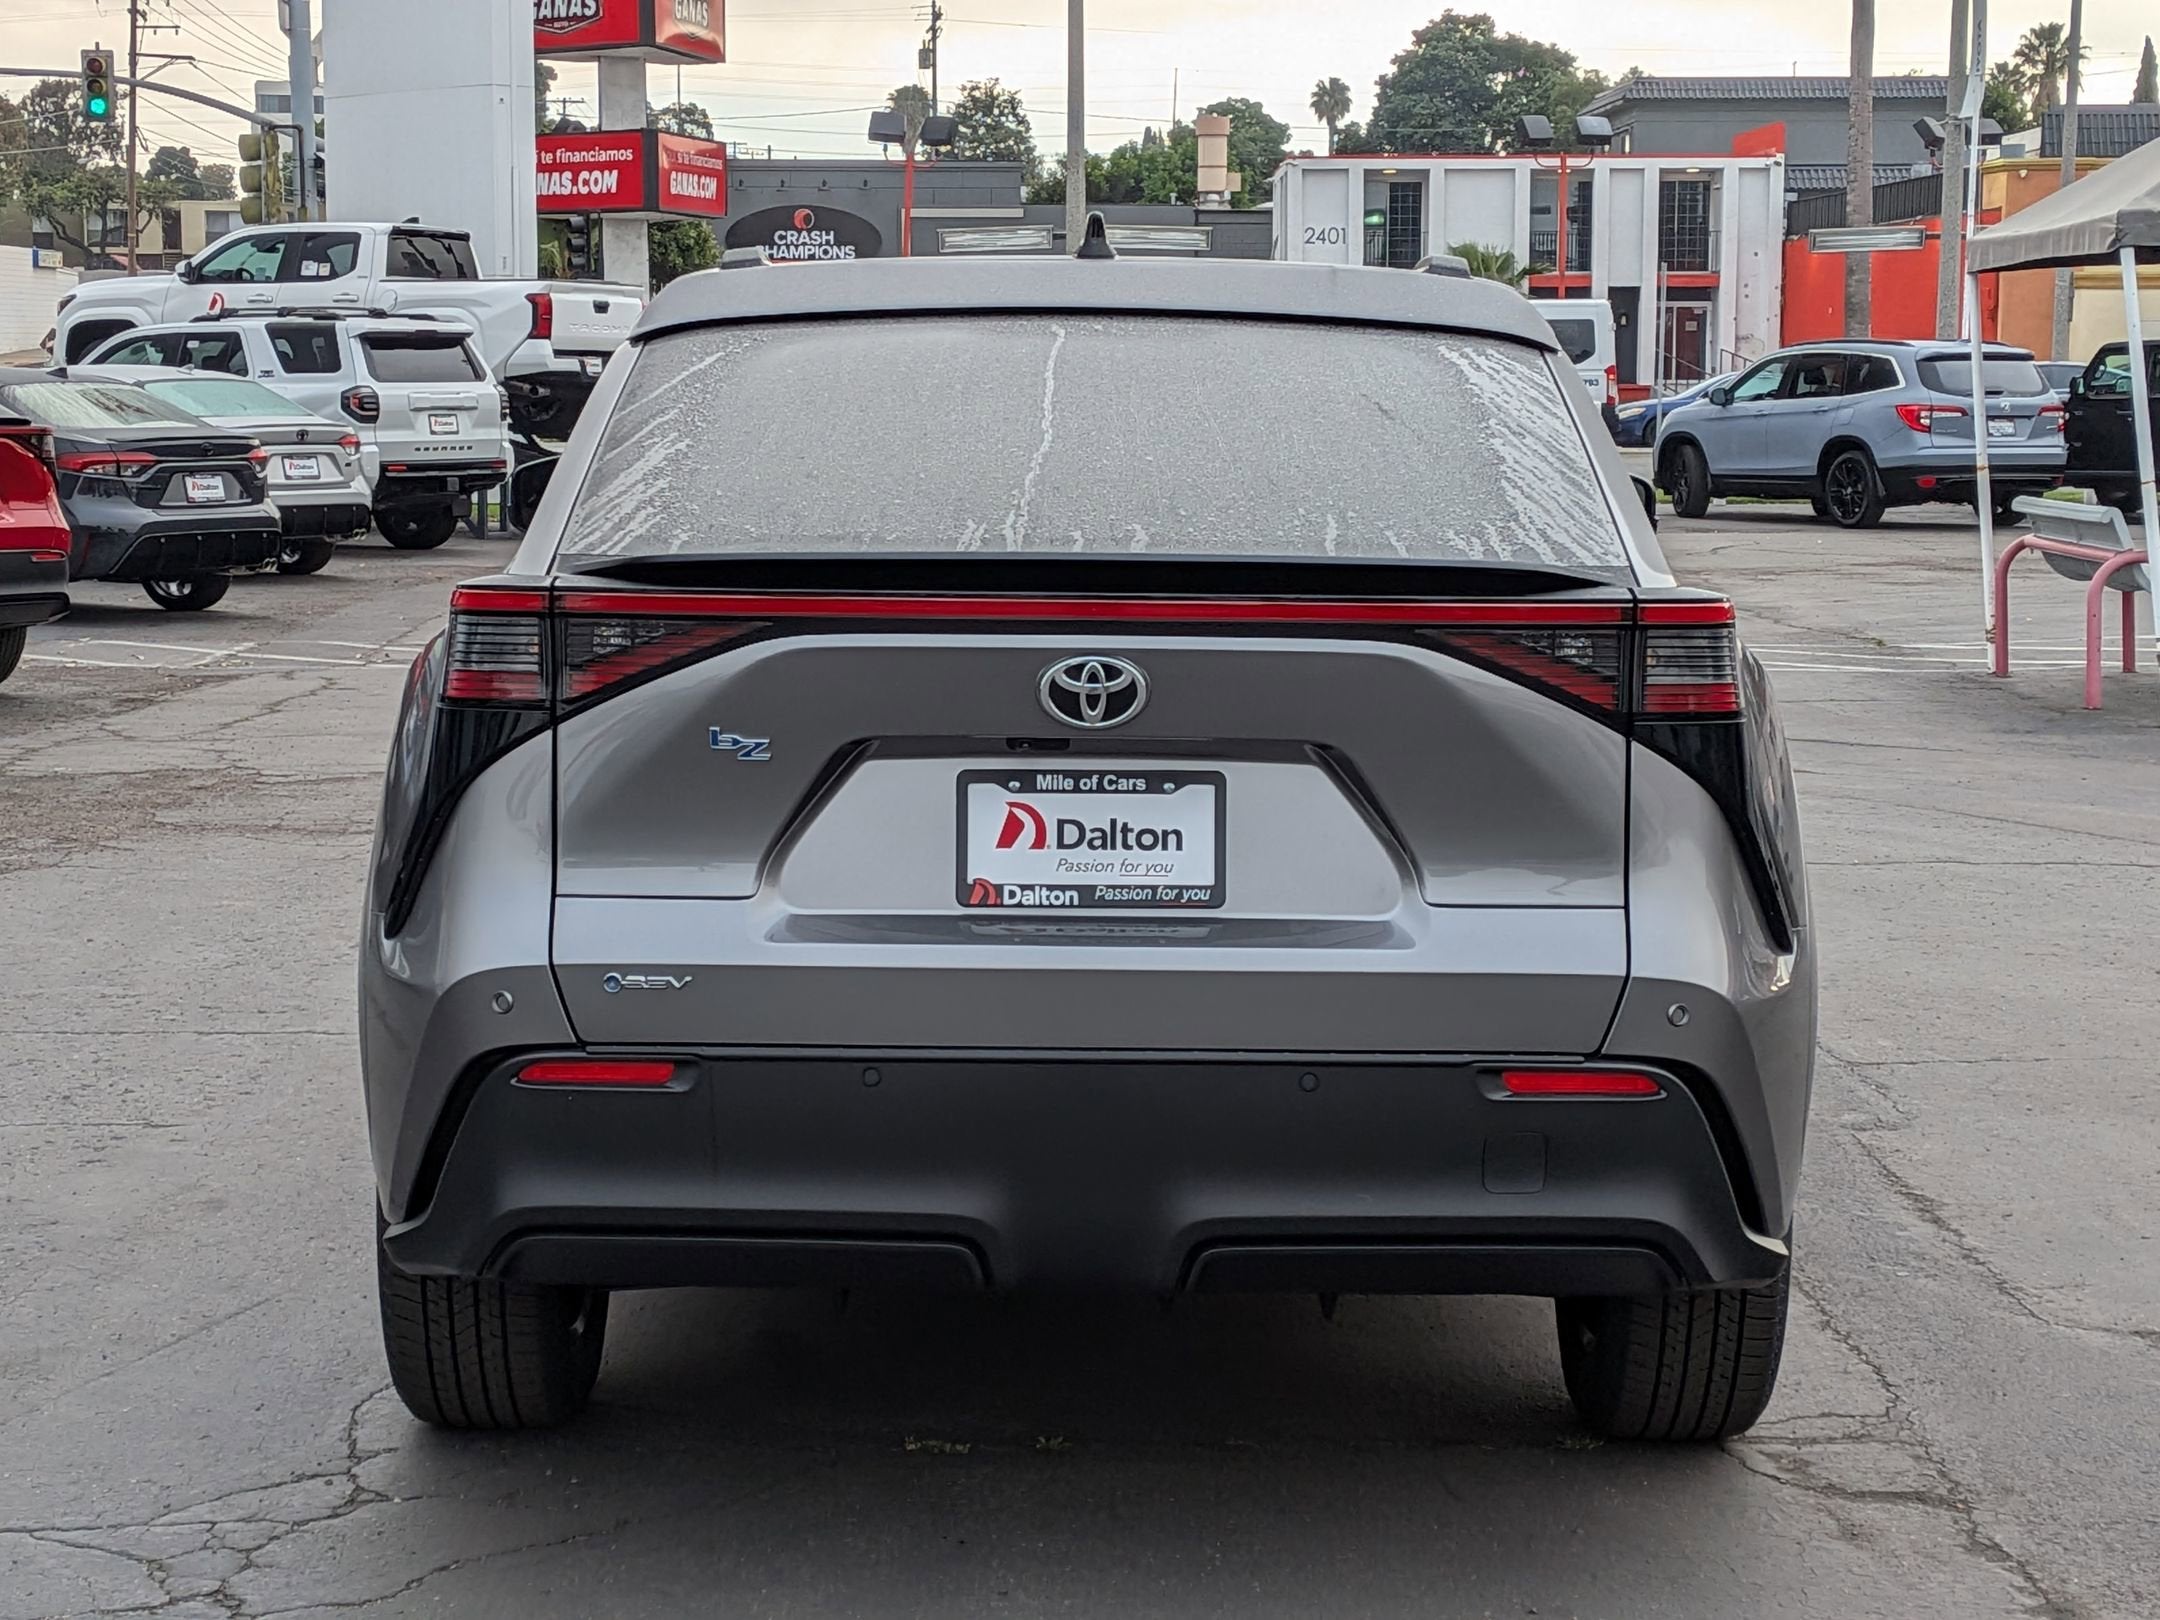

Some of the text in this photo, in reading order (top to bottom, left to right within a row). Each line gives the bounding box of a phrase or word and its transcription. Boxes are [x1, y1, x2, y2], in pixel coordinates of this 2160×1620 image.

[541, 151, 553, 164] te
[556, 147, 633, 164] financiamos
[536, 169, 619, 195] NAS.COM
[670, 171, 718, 200] GANAS.COM
[773, 230, 835, 245] CRASH
[1304, 226, 1346, 244] 2401
[1036, 774, 1147, 791] Mile of Cars
[1056, 818, 1183, 851] Dalton
[1056, 858, 1174, 877] Passion for you
[1003, 886, 1211, 906] Dalton Passion for you
